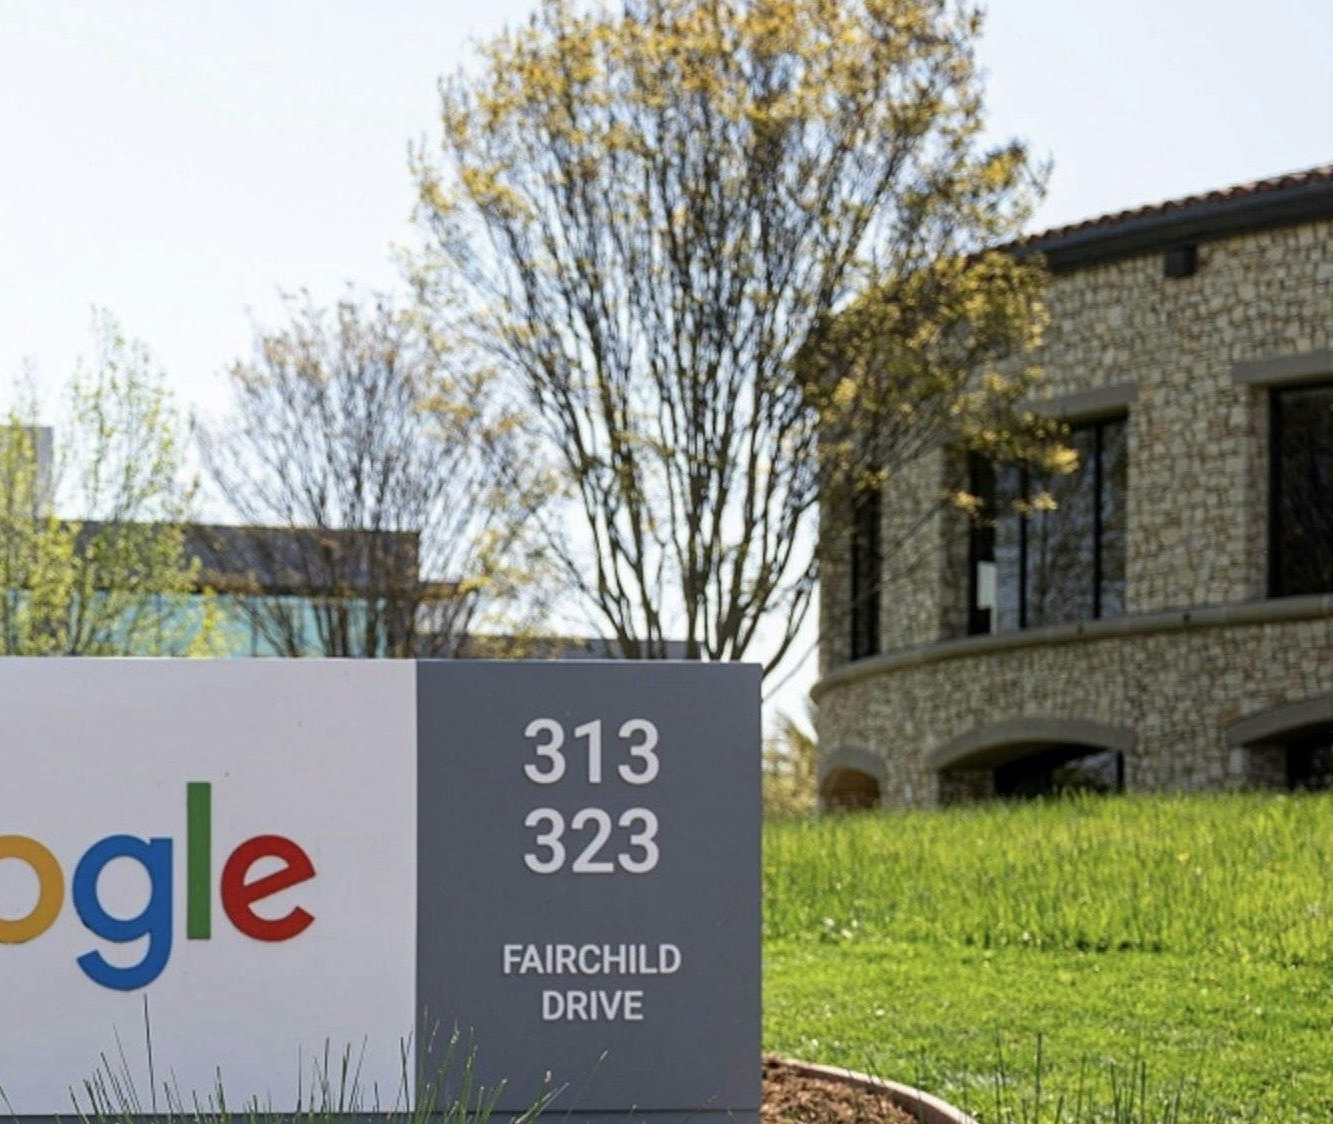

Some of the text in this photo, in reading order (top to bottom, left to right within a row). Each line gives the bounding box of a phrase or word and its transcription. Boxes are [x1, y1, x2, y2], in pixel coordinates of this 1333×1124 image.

[524, 718, 660, 784] 313
[524, 807, 660, 874] 323
[503, 943, 682, 974] FAIRCHILD
[542, 990, 644, 1021] DRIVE
